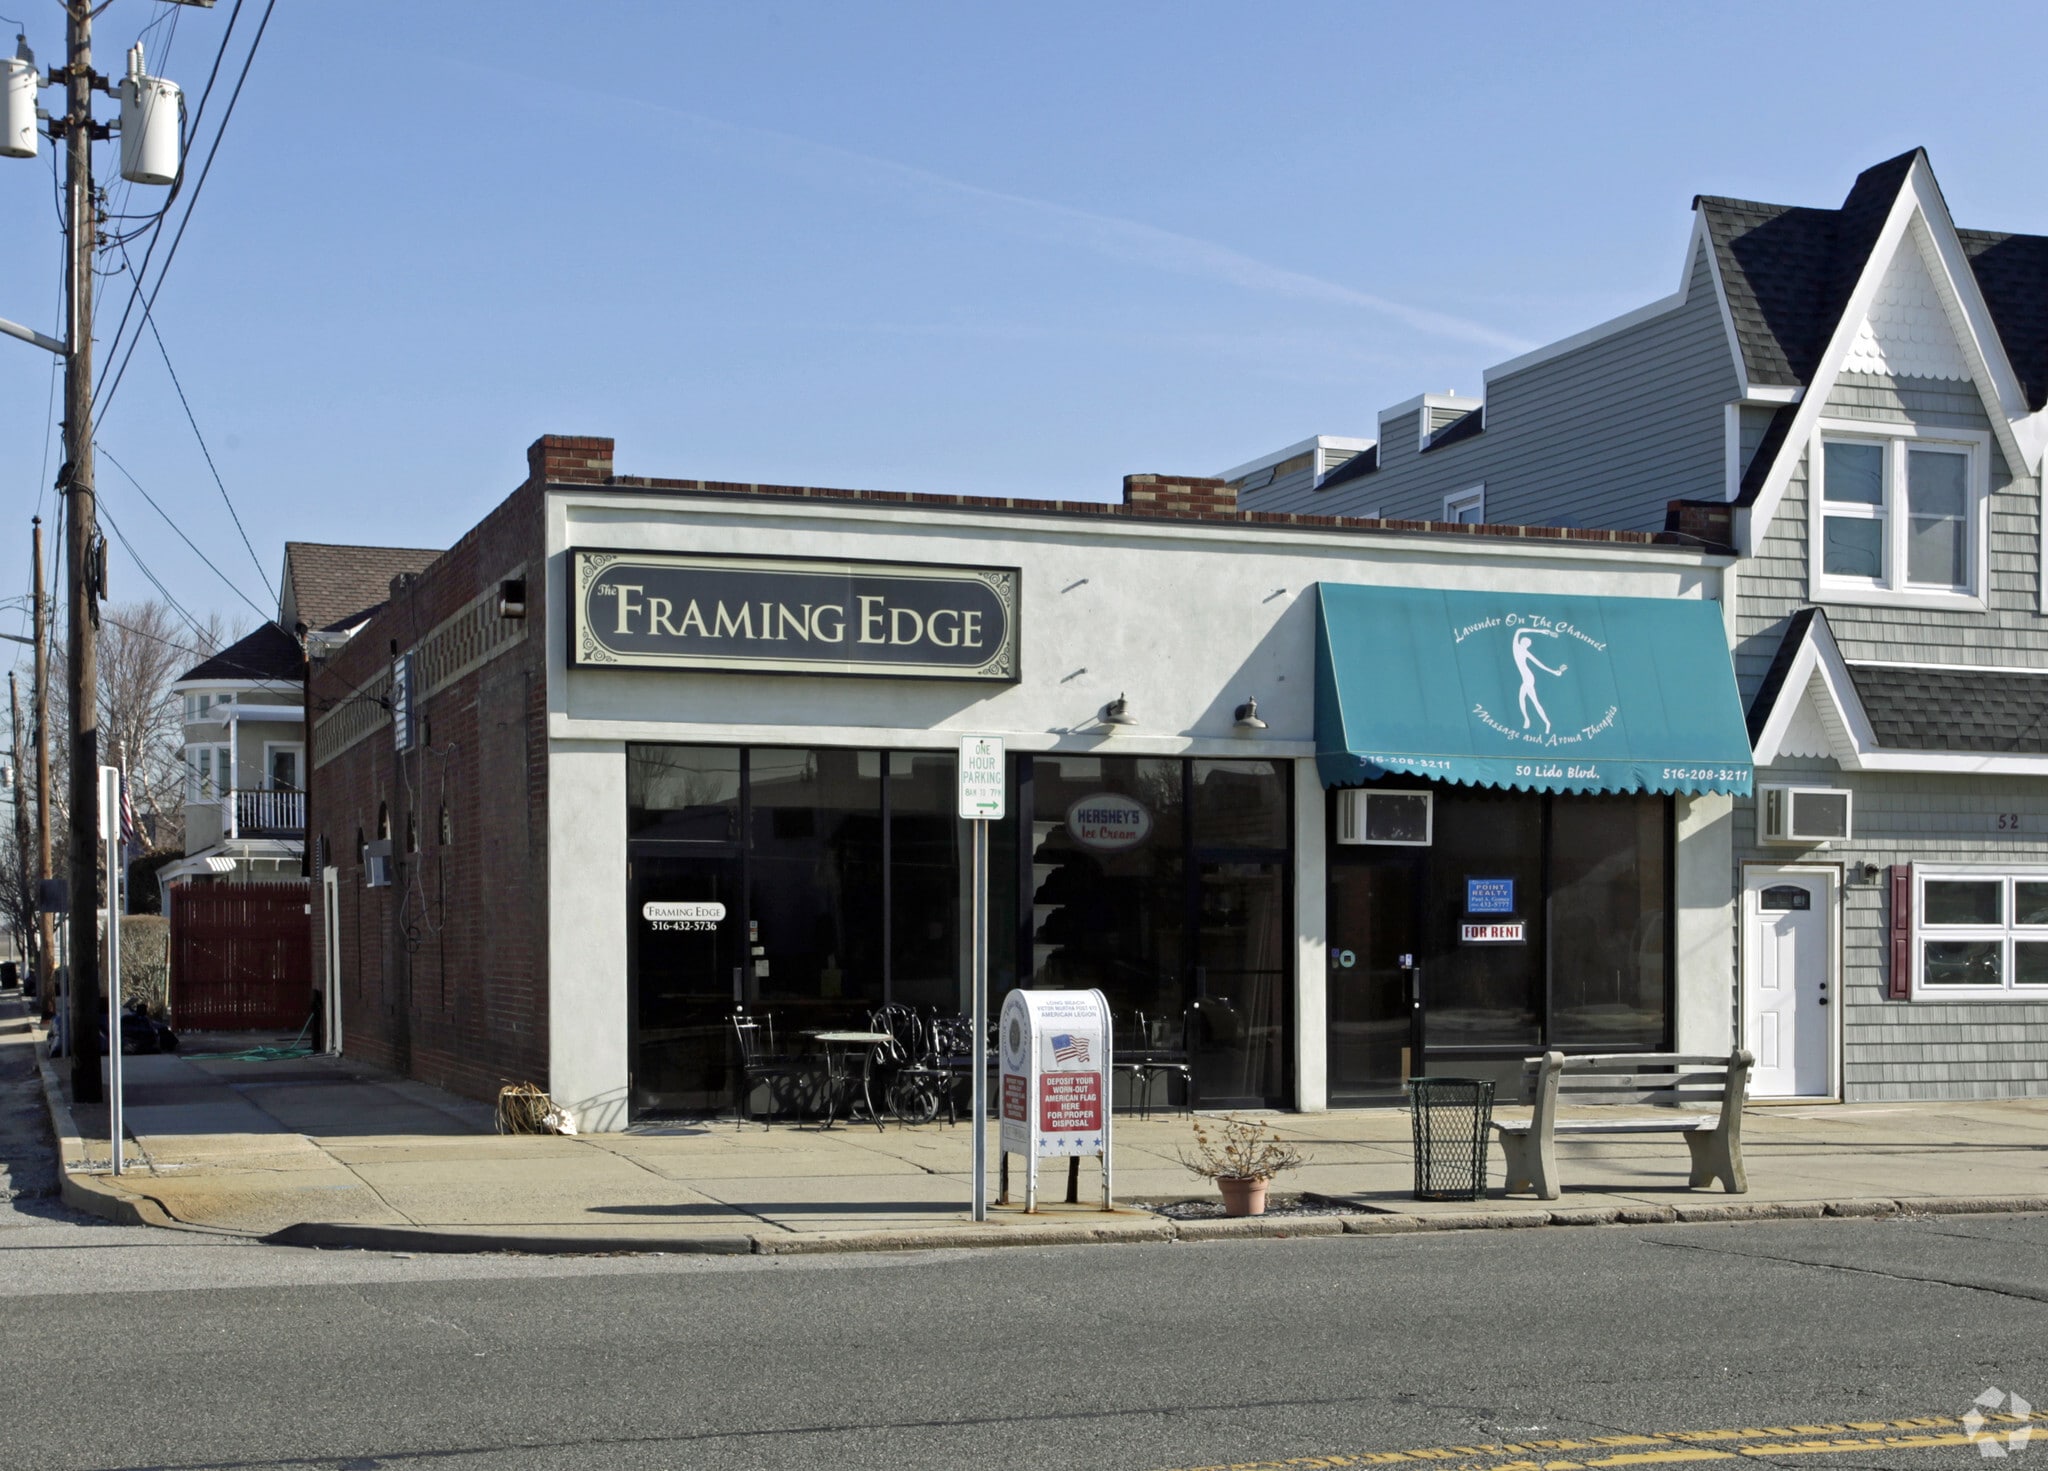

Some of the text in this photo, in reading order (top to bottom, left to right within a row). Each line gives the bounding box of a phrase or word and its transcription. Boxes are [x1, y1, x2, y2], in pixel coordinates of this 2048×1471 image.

[597, 583, 617, 597] The
[614, 584, 982, 648] FRAMING EDGE
[1454, 613, 1607, 652] Lavender On The Channel
[1472, 703, 1618, 746] Massage and Aroma Therapies
[975, 744, 991, 755] ONE
[969, 757, 995, 769] HOUR
[1360, 754, 1451, 769] 516-208-3211
[963, 771, 1002, 784] PARKING
[1515, 765, 1600, 779] 50 Lido Blvd.
[1662, 767, 1748, 782] 516-208-3211
[1077, 809, 1140, 825] HERSHEY'S
[1082, 826, 1137, 840] Ice Cream
[649, 906, 693, 916] FRAMING
[696, 907, 720, 916] EDGE
[652, 921, 717, 931] 516-432-5736
[1465, 926, 1520, 938] FOR RENT
[1046, 1076, 1094, 1085] DEPOSIT YOUR
[1079, 1094, 1096, 1102] FLAG
[1061, 1102, 1080, 1110] HERE
[1047, 1111, 1094, 1119] FOR PROPER
[1052, 1119, 1089, 1128] DISPOSAL
